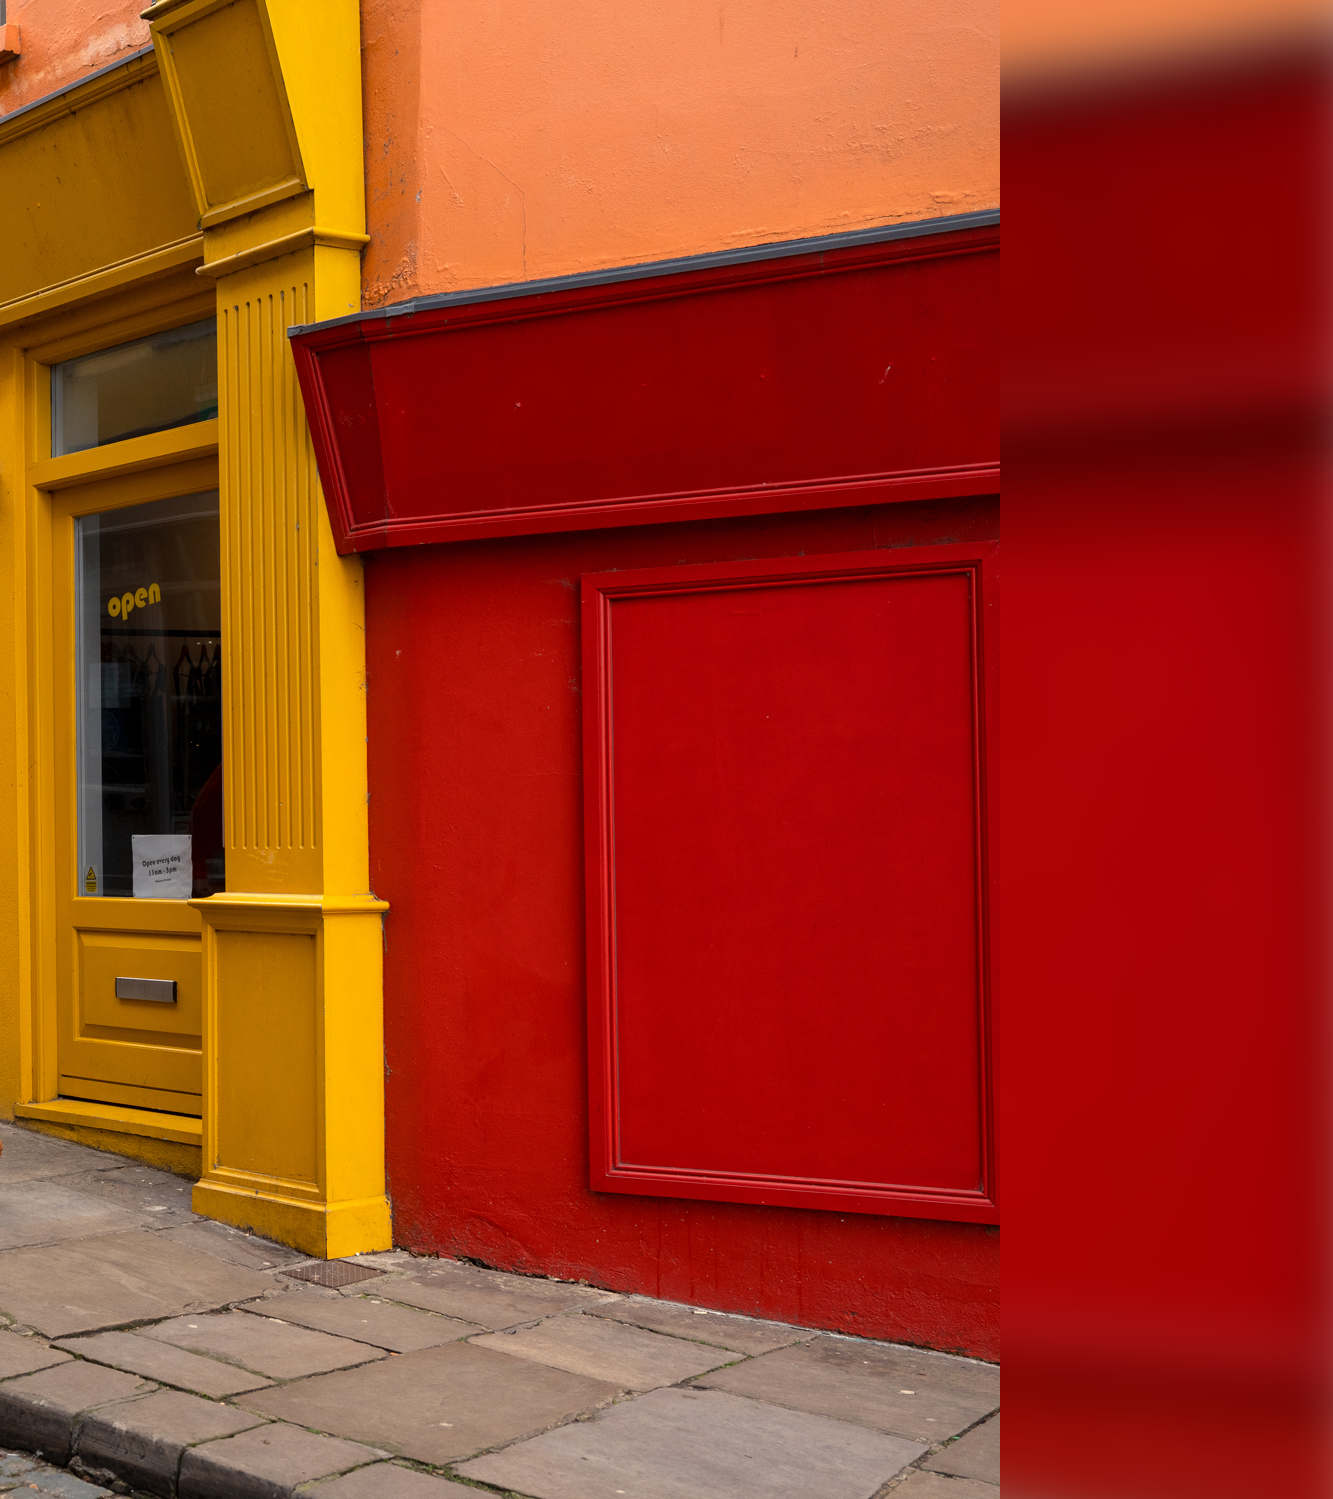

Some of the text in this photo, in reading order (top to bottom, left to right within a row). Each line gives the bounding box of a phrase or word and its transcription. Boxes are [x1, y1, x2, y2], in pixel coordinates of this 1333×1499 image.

[108, 583, 161, 621] open
[142, 855, 181, 868] Open every day
